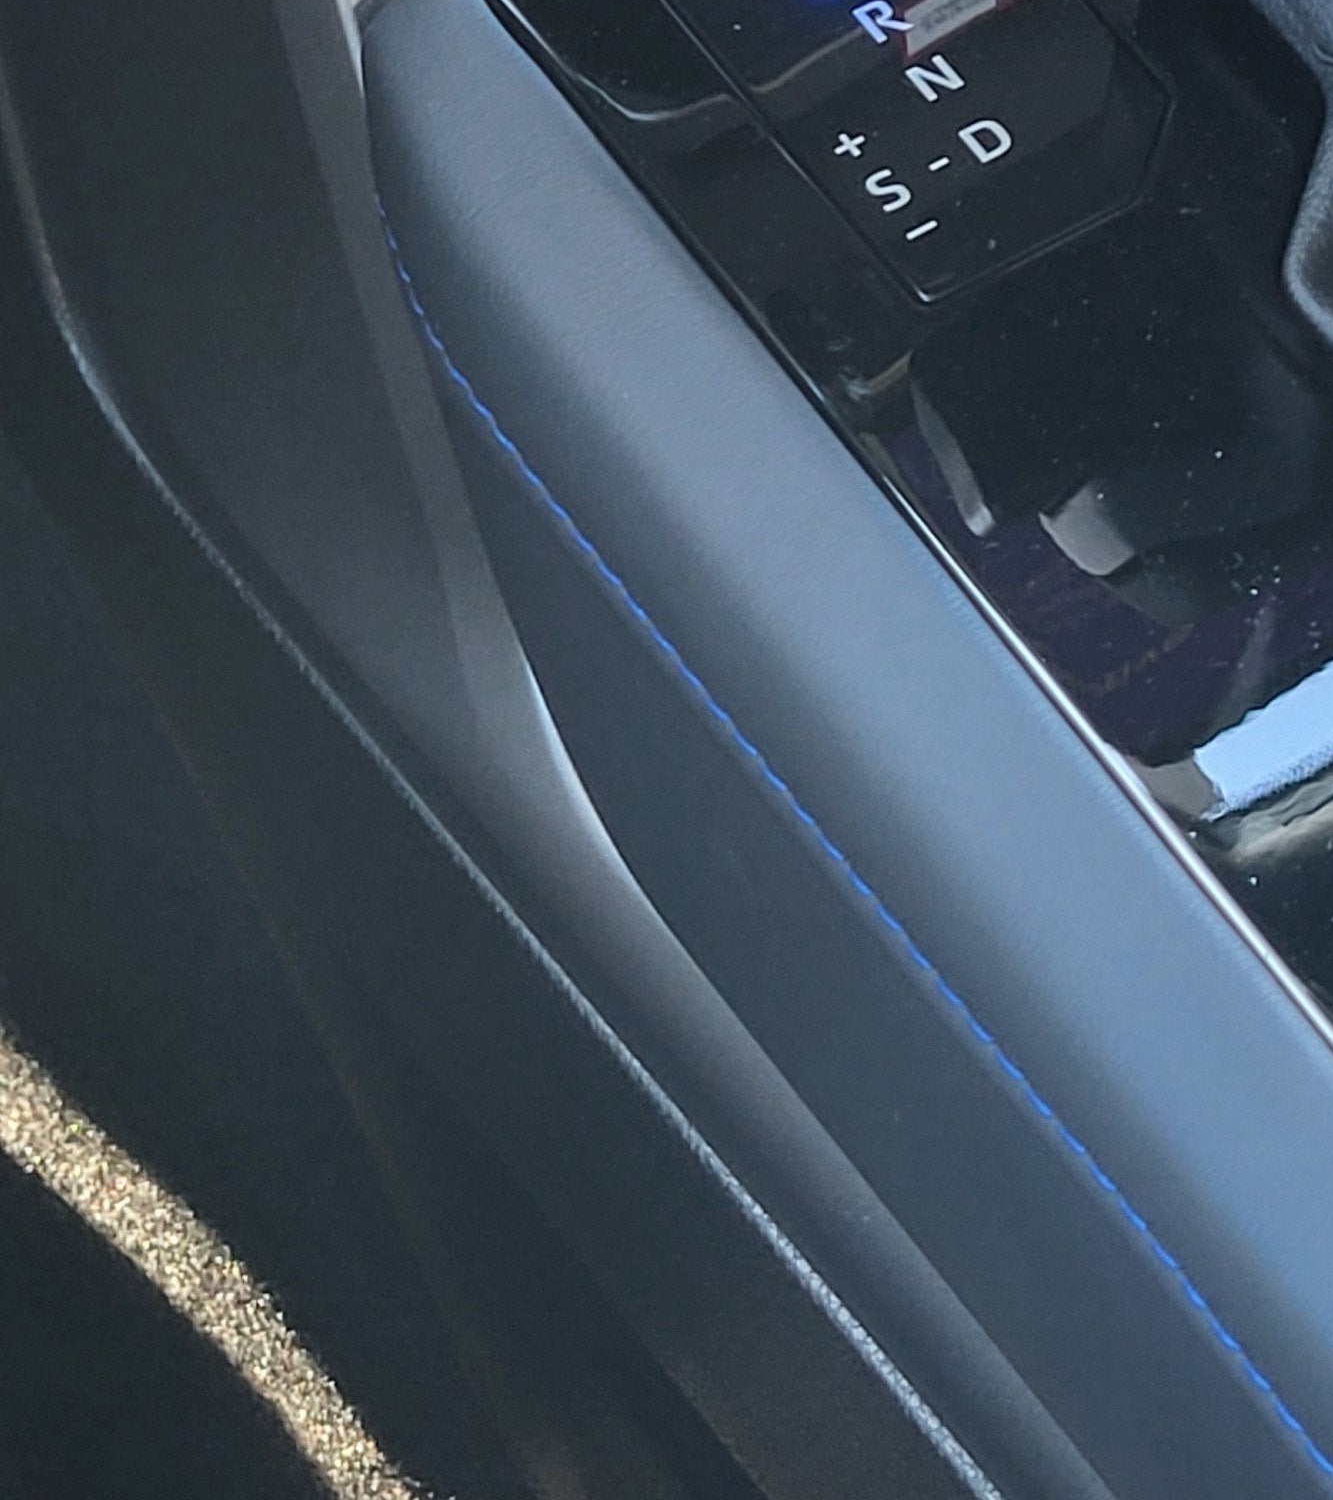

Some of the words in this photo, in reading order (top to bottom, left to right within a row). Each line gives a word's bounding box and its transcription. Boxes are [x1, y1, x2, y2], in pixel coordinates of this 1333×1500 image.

[852, 0, 914, 44] R
[905, 54, 966, 102] N
[865, 168, 912, 212] S
[958, 119, 1012, 164] D
